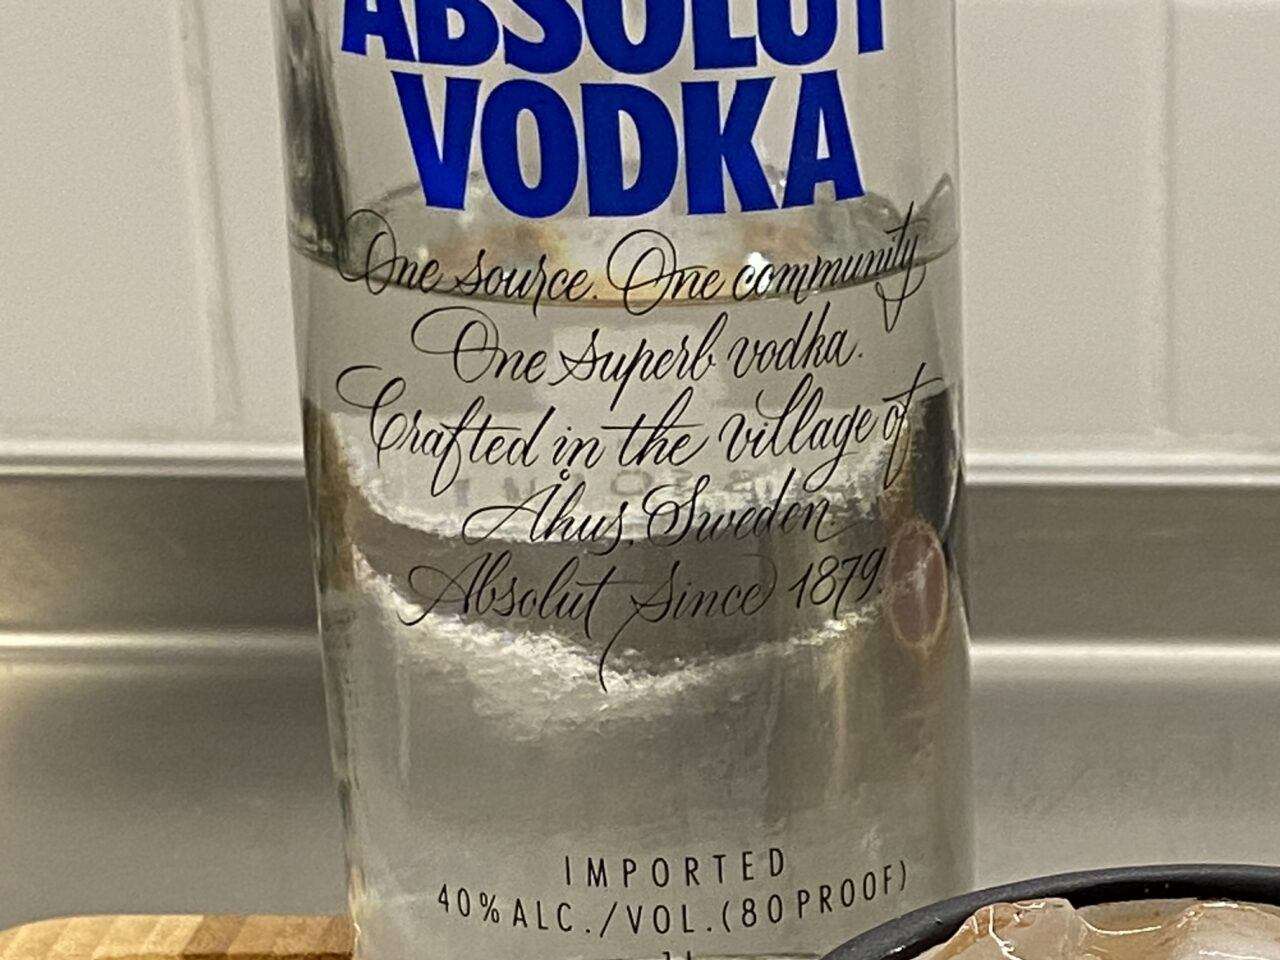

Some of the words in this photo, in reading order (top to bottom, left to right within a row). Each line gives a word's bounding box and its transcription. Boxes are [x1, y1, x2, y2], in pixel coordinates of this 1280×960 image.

[390, 69, 866, 218] VODKA
[336, 208, 446, 296] One
[450, 248, 600, 320] source.
[606, 228, 726, 316] One
[410, 305, 549, 384] One
[727, 300, 863, 379] vodka.
[335, 364, 556, 497] Crafted
[551, 425, 605, 469] in
[600, 386, 707, 467] the
[718, 372, 880, 493] village
[881, 362, 944, 490] of
[461, 467, 636, 556] Åhus,
[642, 466, 862, 547] Sweden.
[396, 550, 645, 640] Absolut
[788, 546, 883, 620] 1879.
[564, 846, 785, 889] IMPORTED
